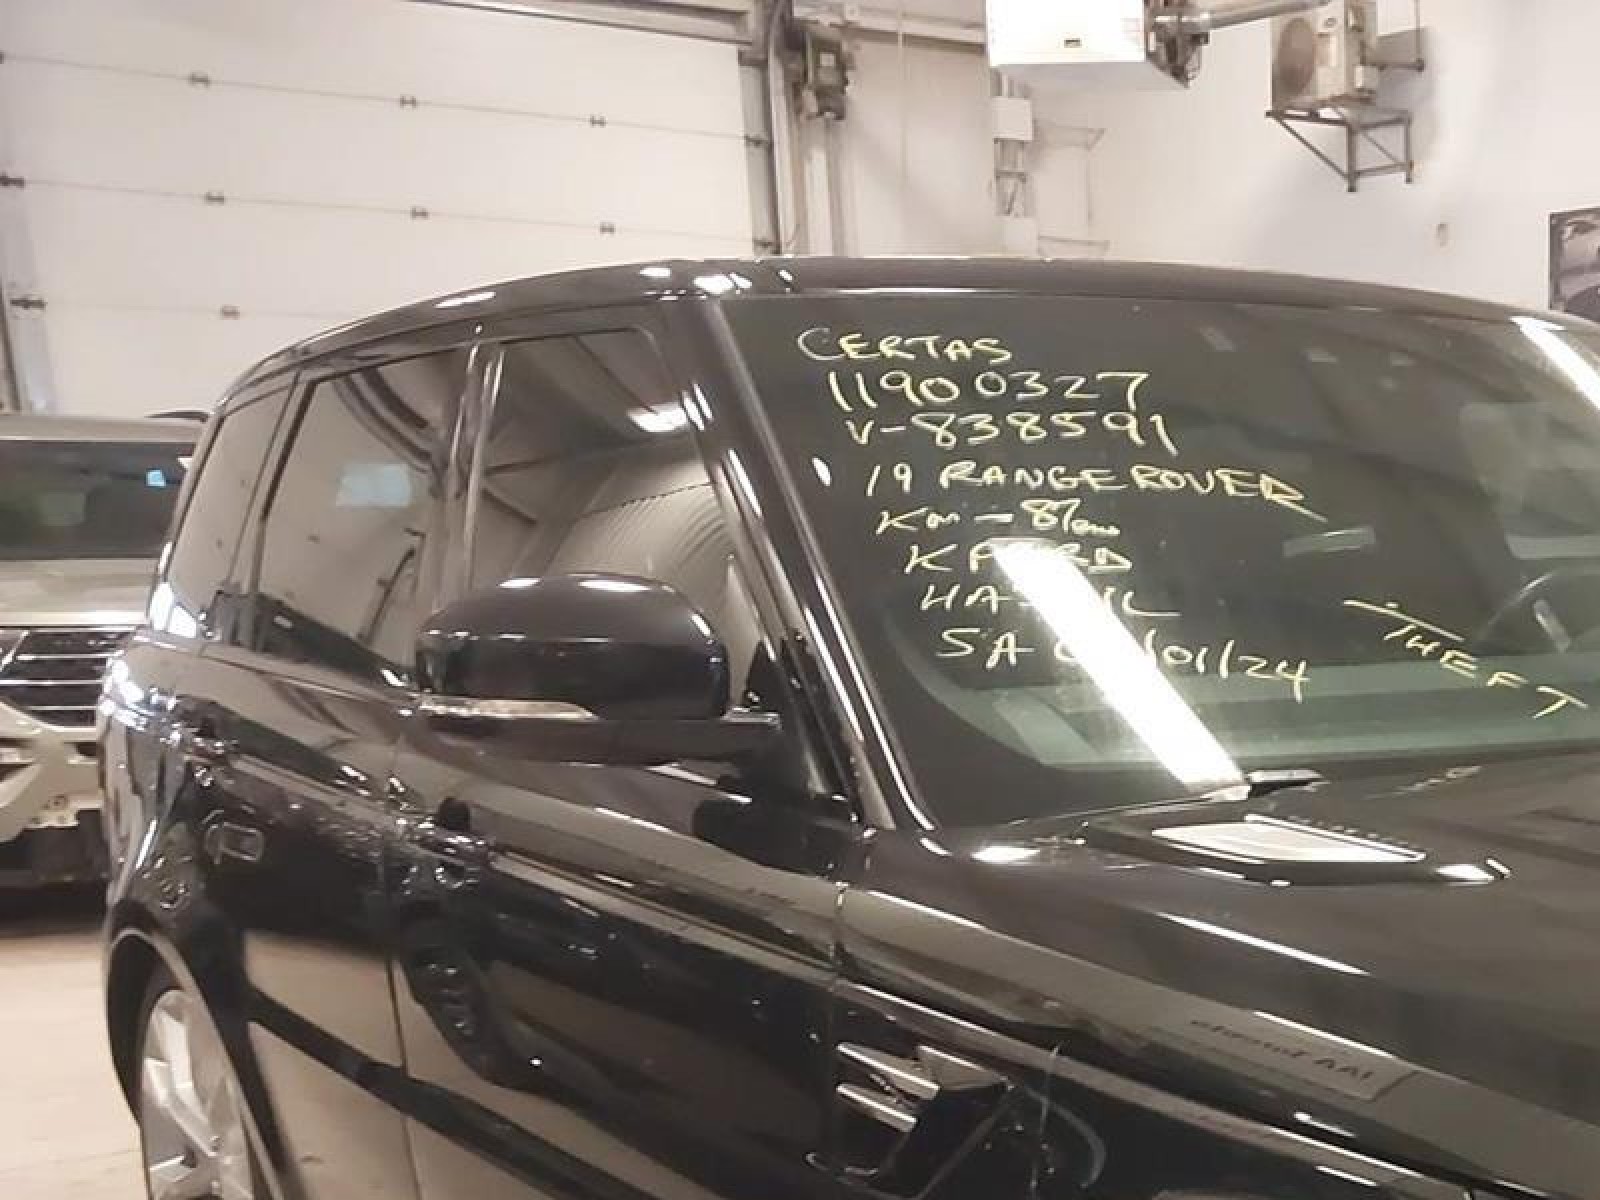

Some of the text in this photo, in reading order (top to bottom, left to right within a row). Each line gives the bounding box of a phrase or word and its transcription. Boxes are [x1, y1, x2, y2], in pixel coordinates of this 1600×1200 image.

[797, 327, 1012, 365] CERTAS
[938, 459, 1128, 491] RANGE
[1129, 463, 1329, 524] ROVER
[1342, 599, 1589, 720] THEFT
